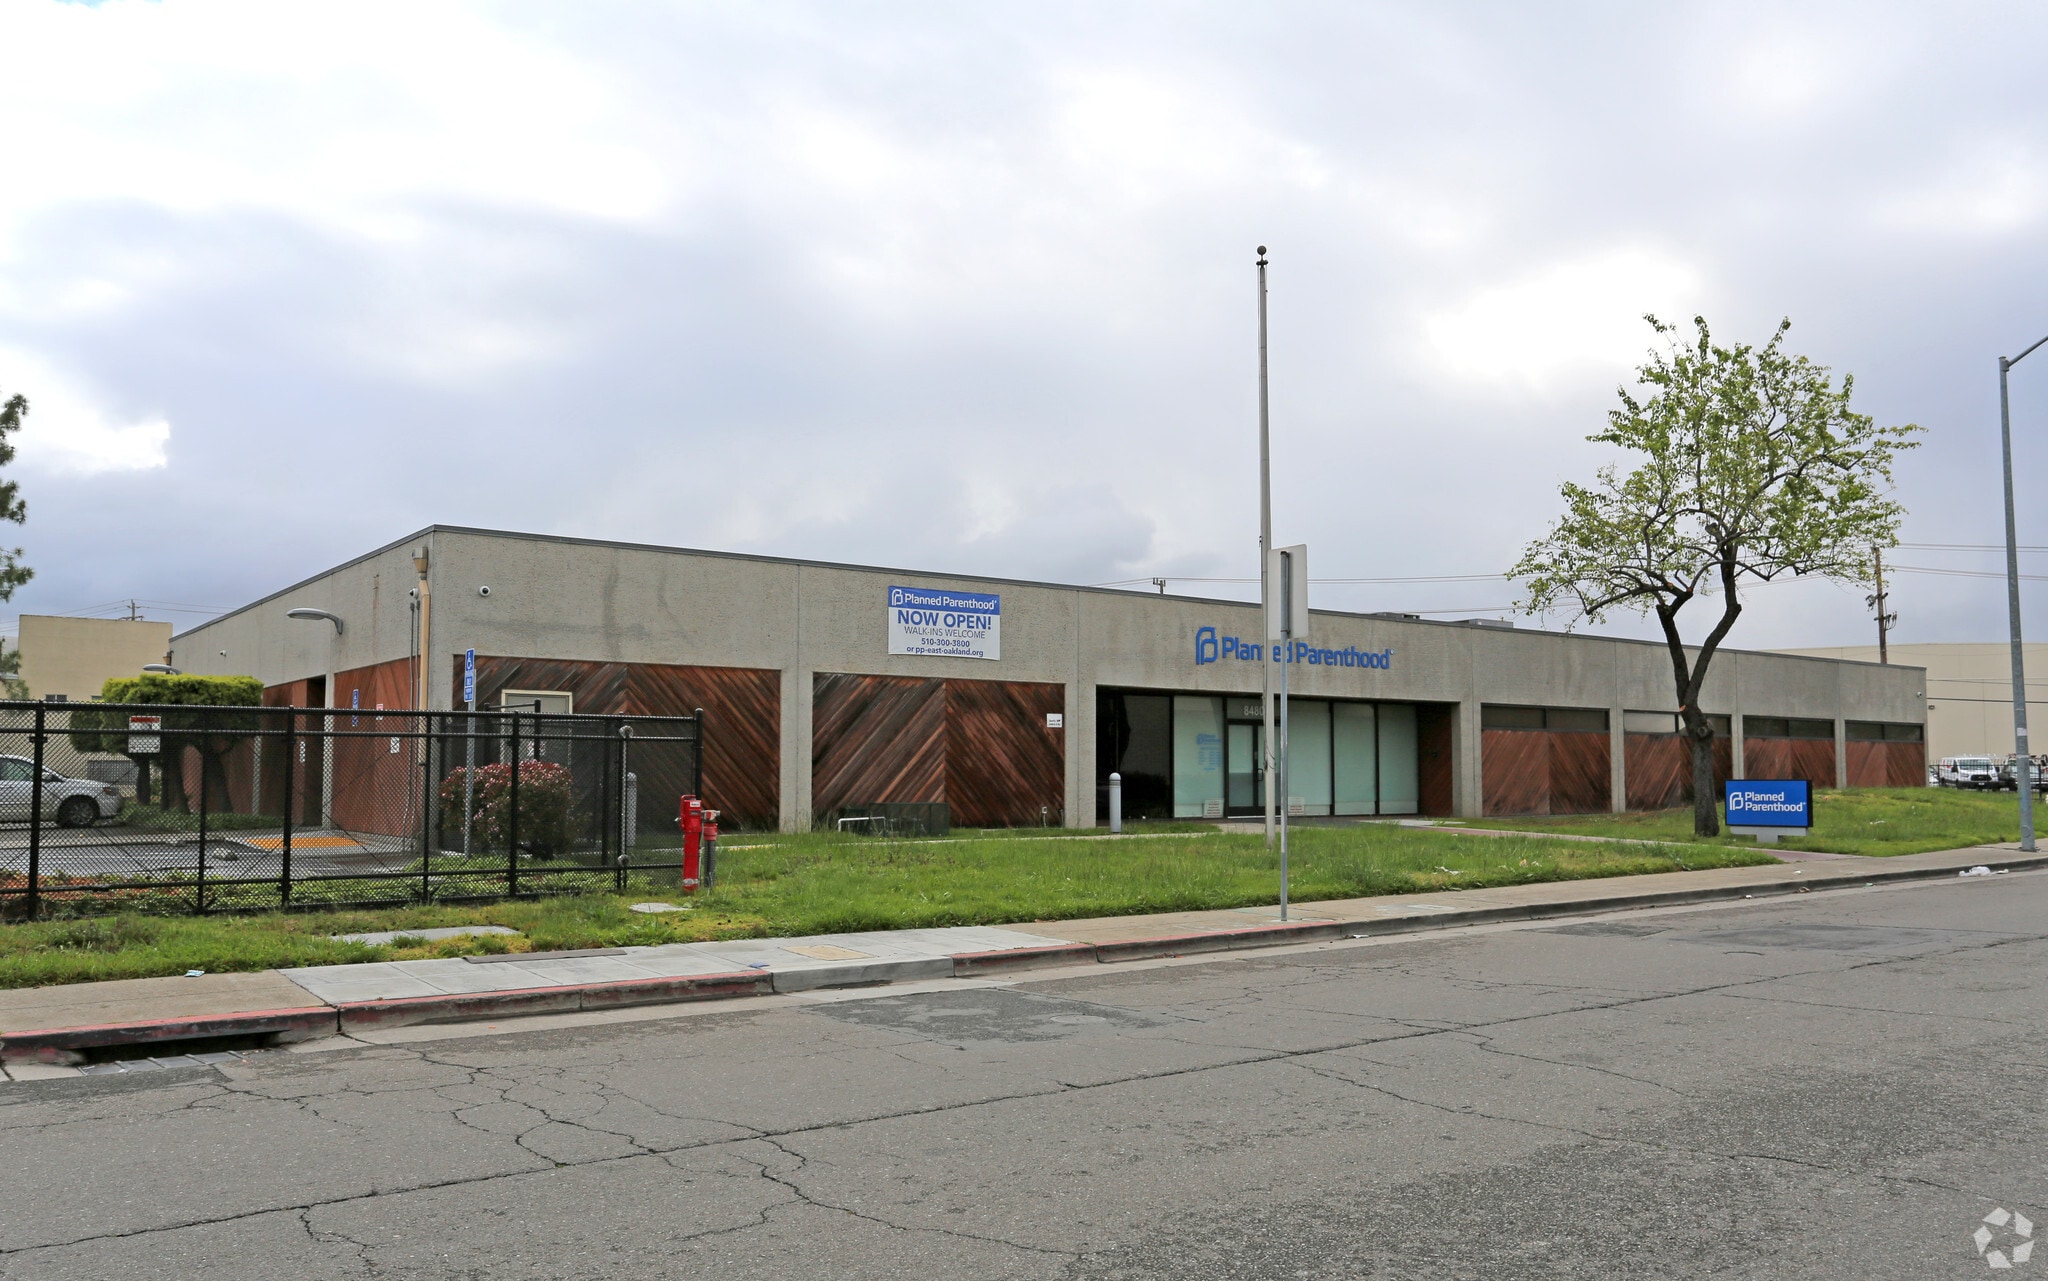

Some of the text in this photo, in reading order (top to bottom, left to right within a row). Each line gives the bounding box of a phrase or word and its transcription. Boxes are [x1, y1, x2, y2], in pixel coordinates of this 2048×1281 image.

[904, 593, 995, 610] Planned Parenthood
[897, 609, 992, 630] NOW OPEN!
[904, 626, 986, 639] WALK-INS WELCOME
[921, 637, 970, 648] 510-300-3800
[1222, 636, 1390, 669] Planed Parenthood
[1243, 705, 1264, 717] 8480
[1745, 791, 1785, 802] Planned
[1745, 802, 1803, 812] Parenthood
